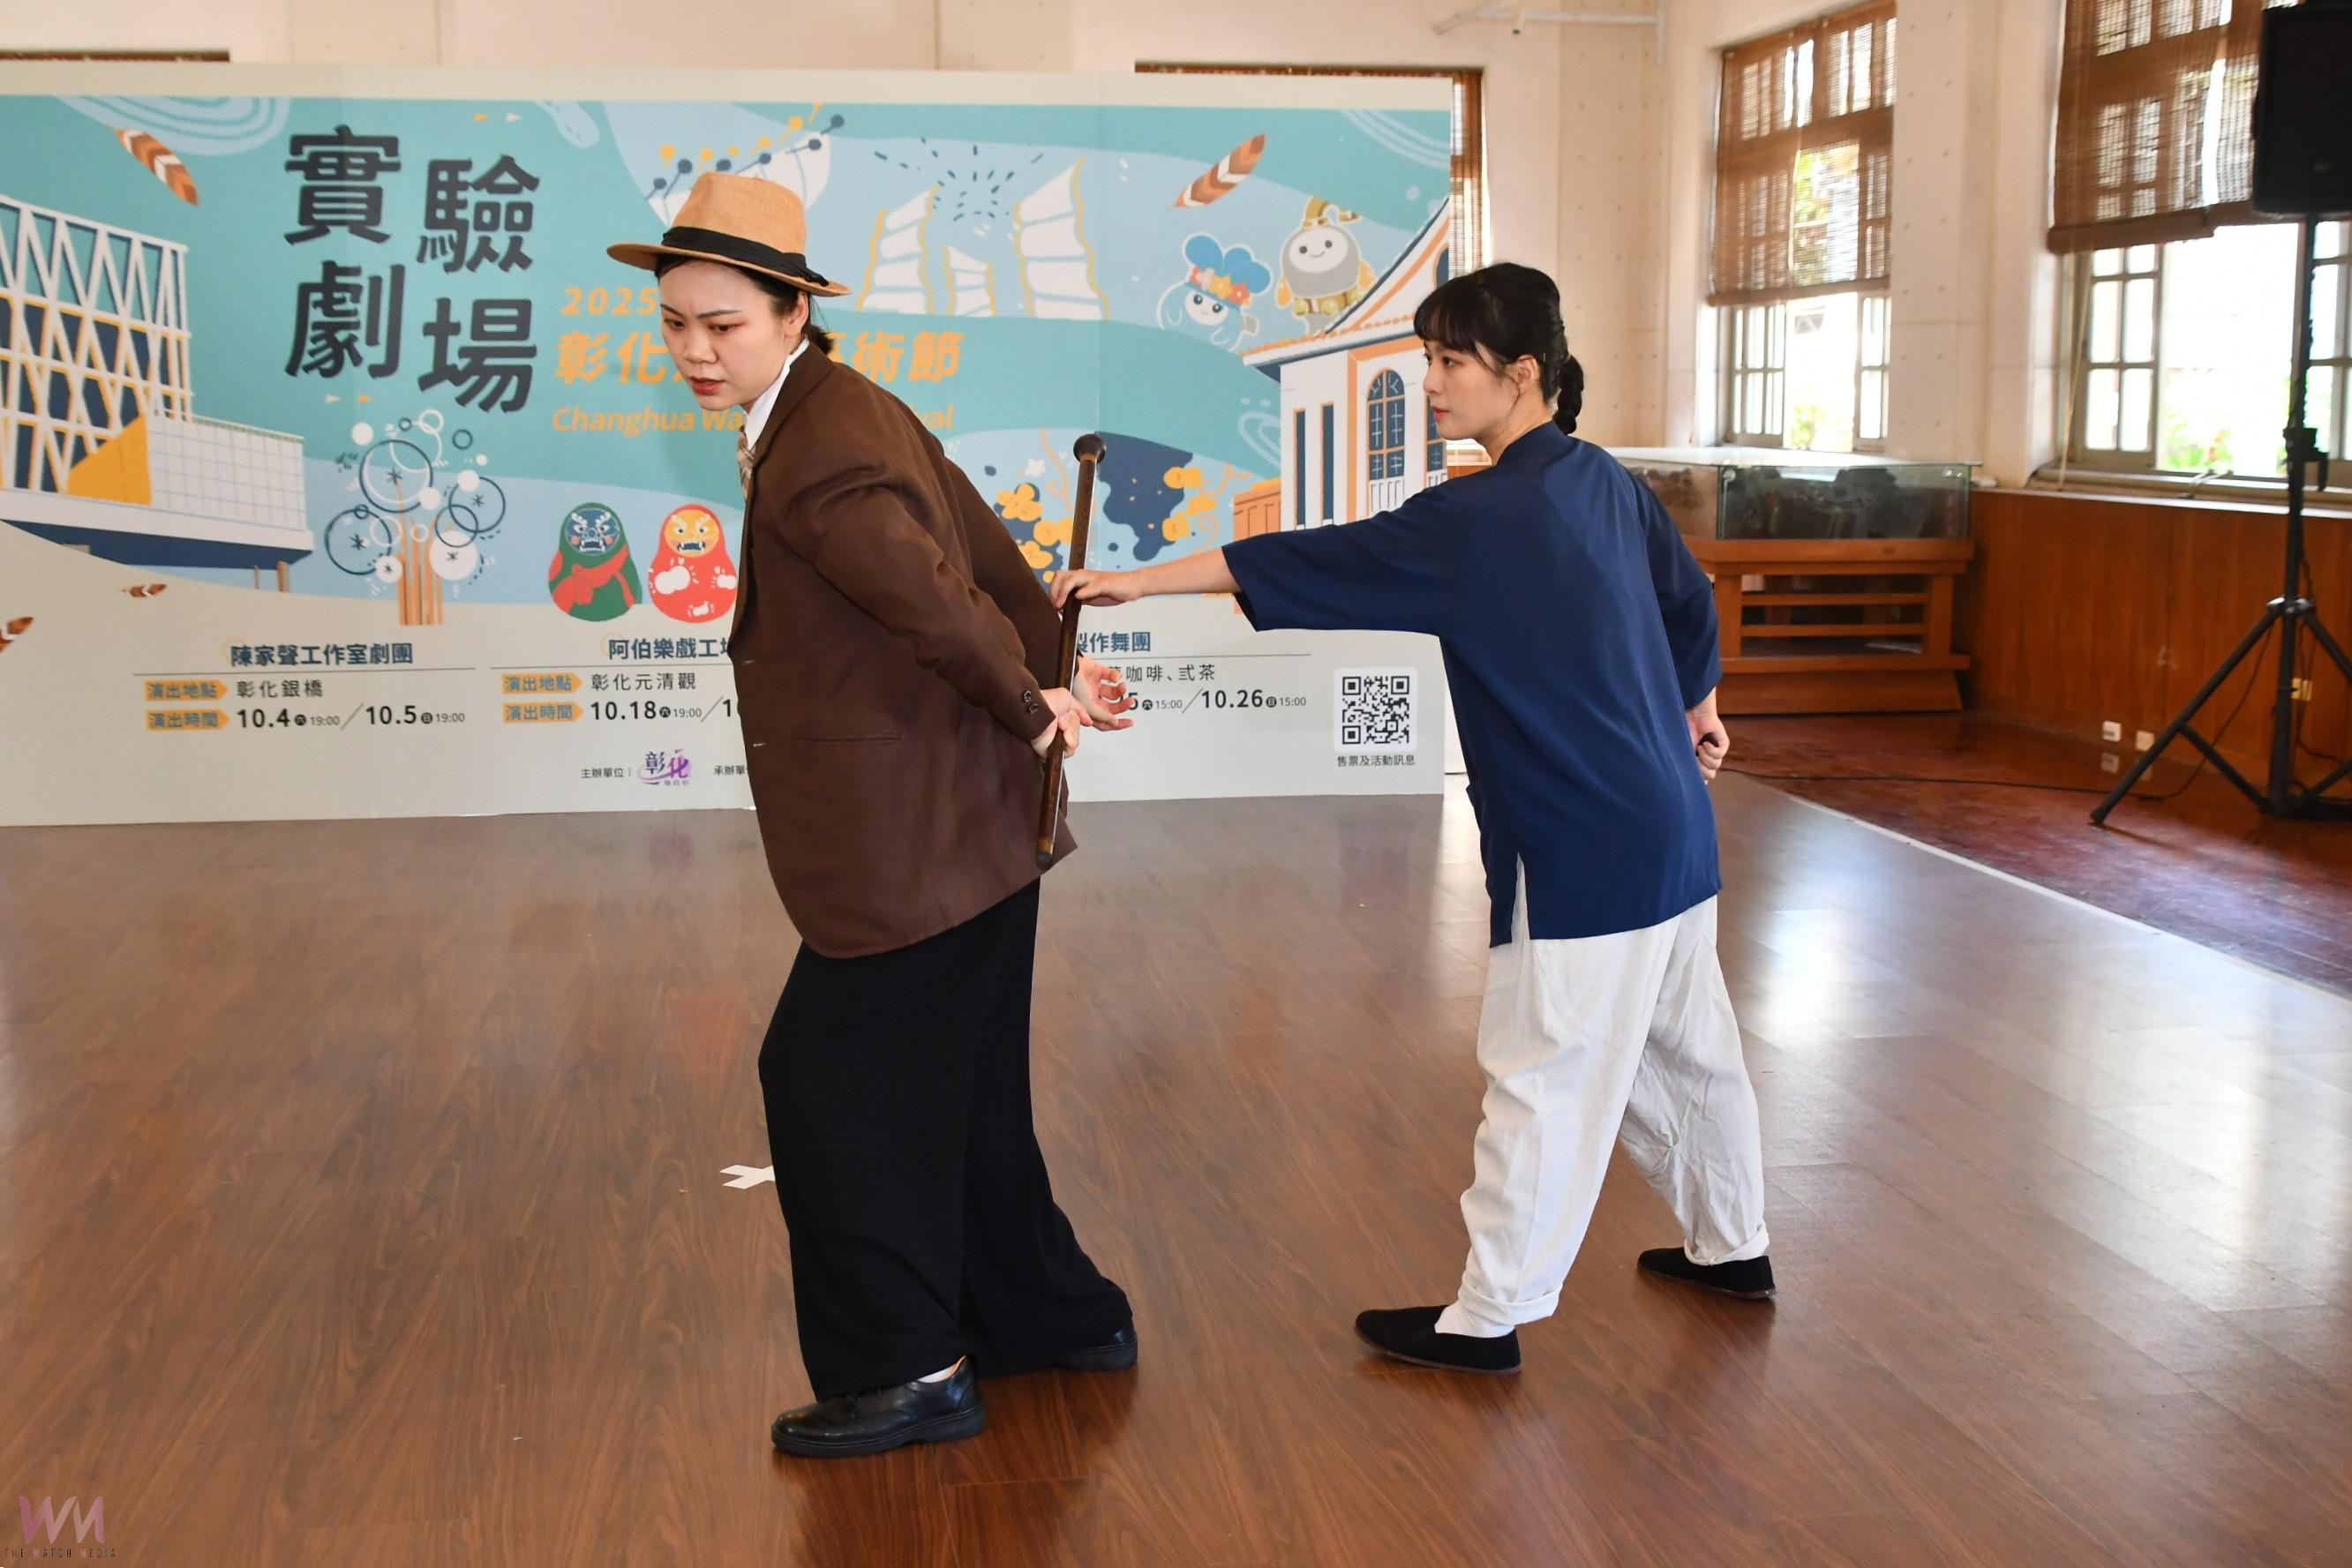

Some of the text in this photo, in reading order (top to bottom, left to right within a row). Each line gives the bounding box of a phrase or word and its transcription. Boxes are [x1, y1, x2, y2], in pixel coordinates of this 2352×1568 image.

[284, 124, 540, 274] 實驗
[560, 287, 658, 316] 2025
[284, 260, 537, 414] 劇場
[552, 406, 695, 438] Changhua
[230, 642, 413, 667] 陳家聲工作室劇團
[236, 679, 323, 698] 彰化銀橋
[505, 672, 695, 692] 演出地點 彰化元清觀
[506, 705, 573, 721] 演出時間
[714, 764, 747, 776] 承辦單
[1337, 754, 1416, 767] 售票及活動訊息
